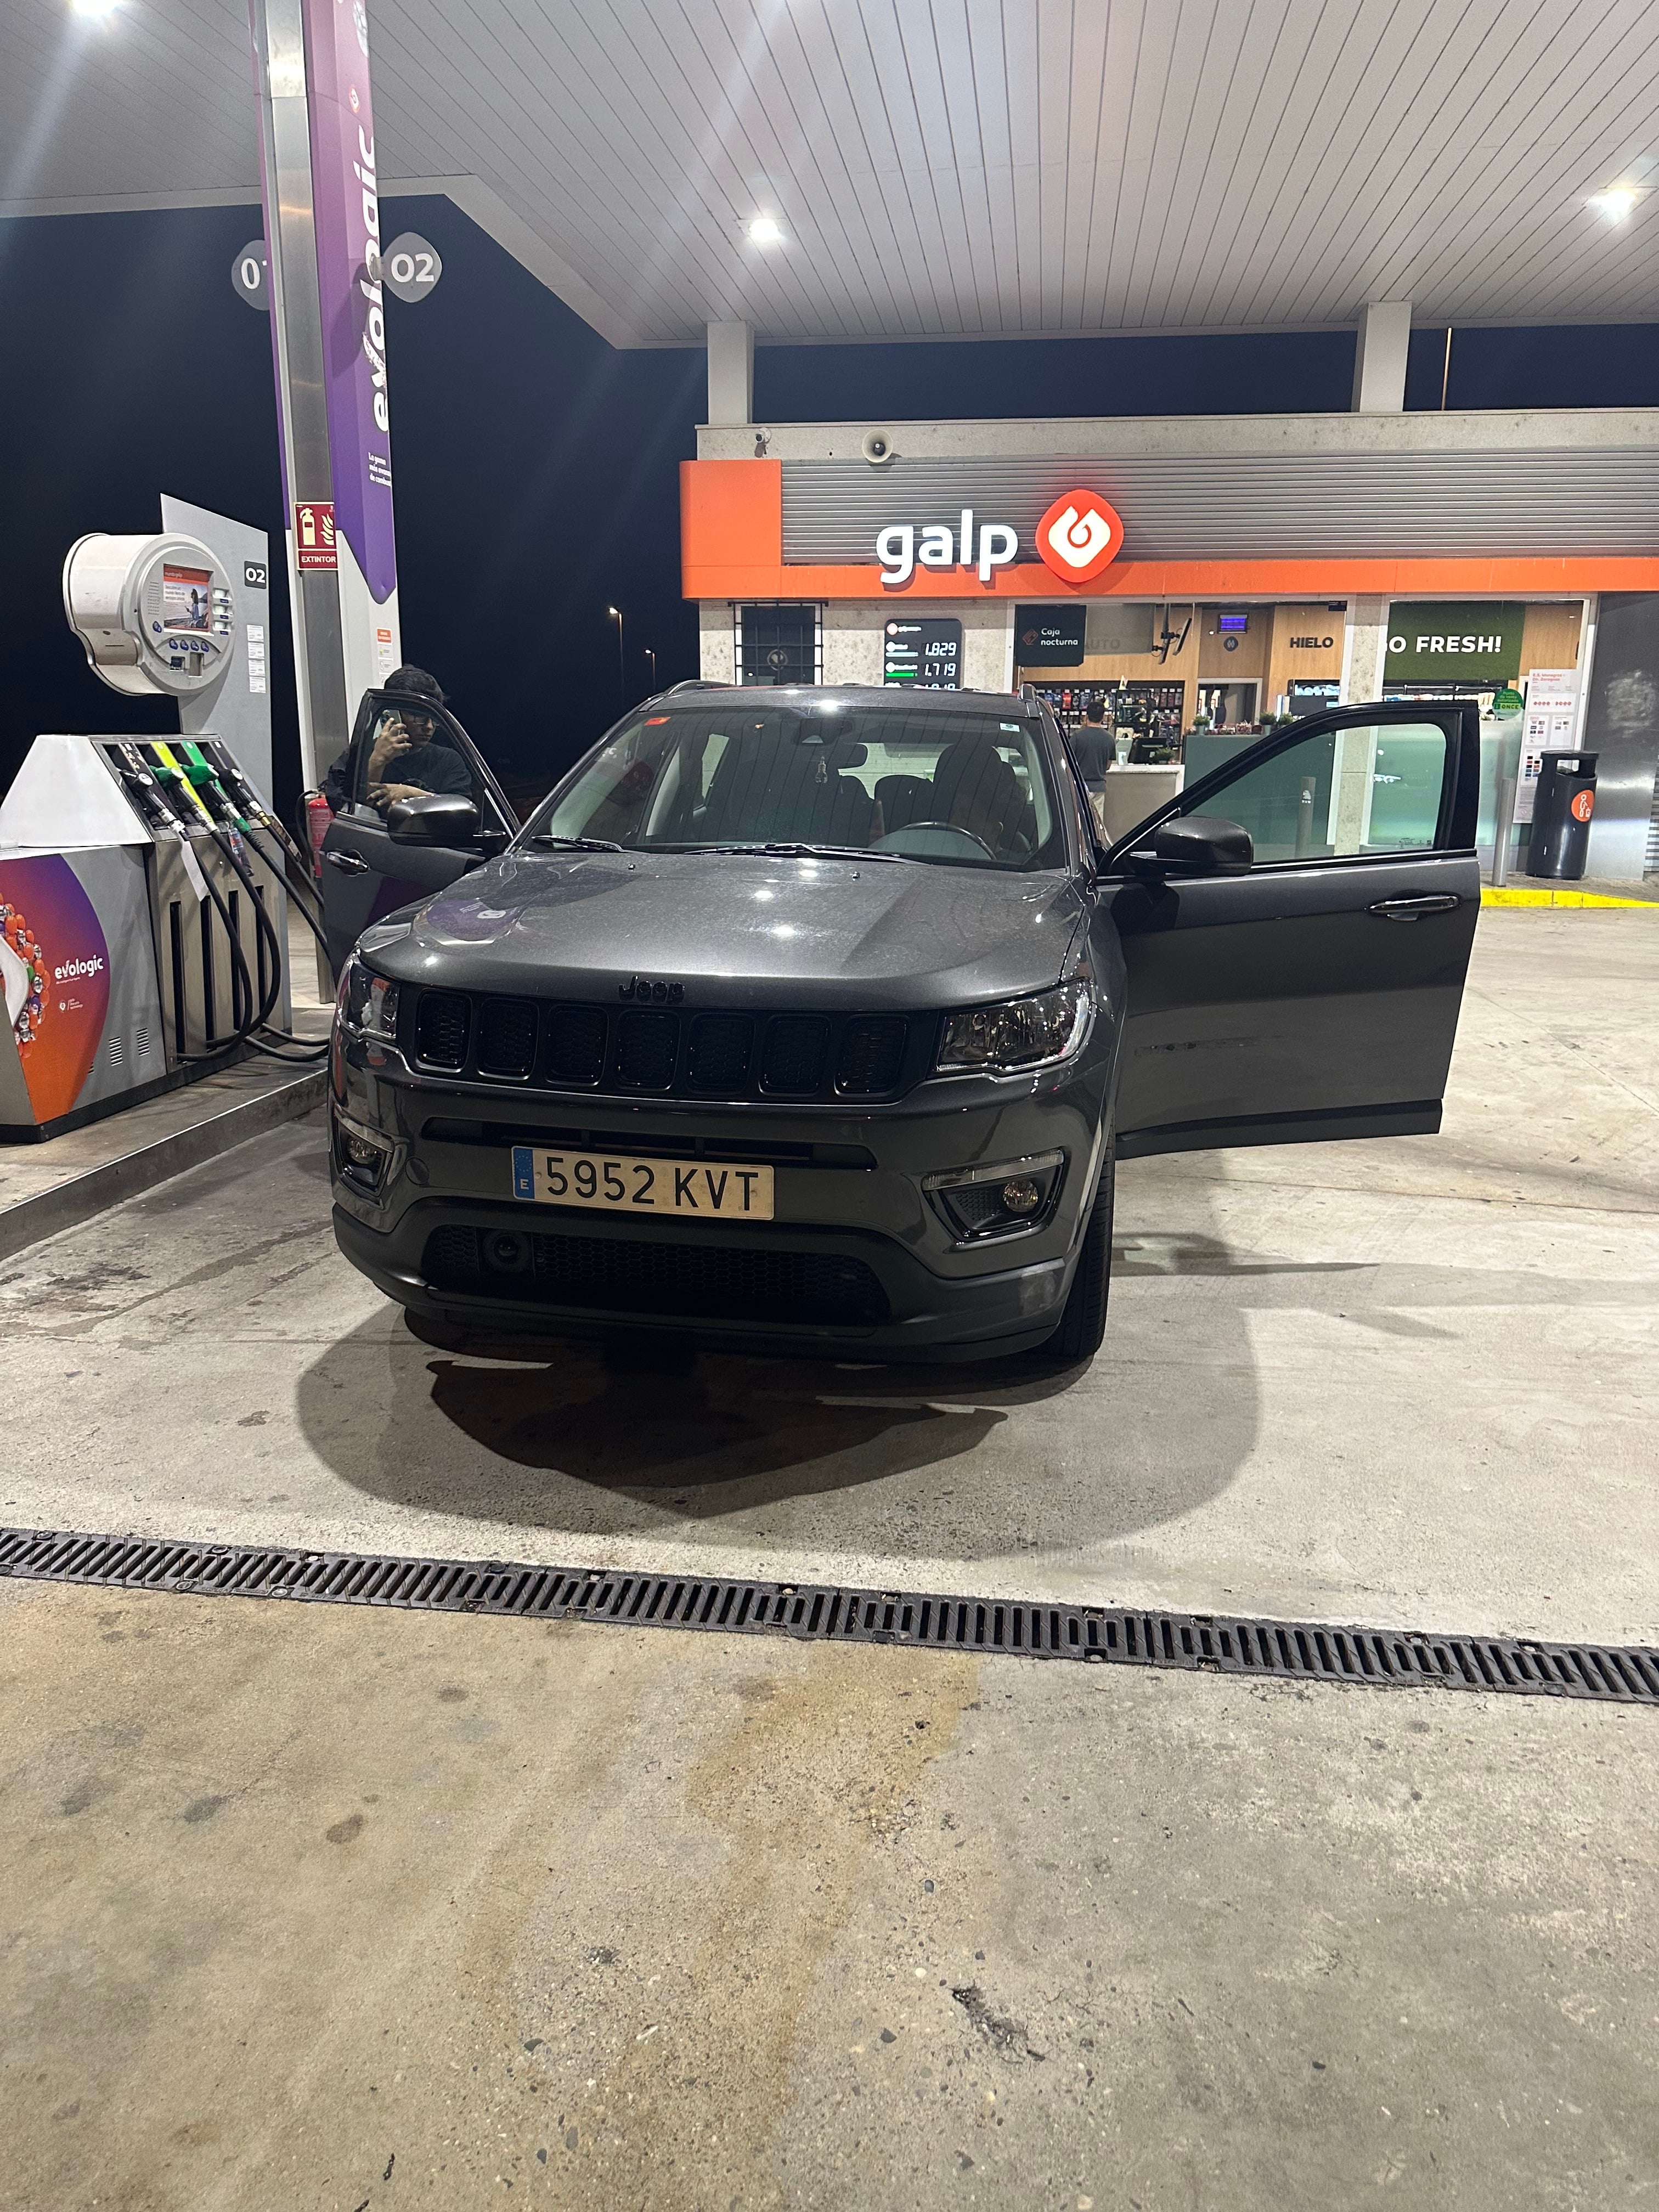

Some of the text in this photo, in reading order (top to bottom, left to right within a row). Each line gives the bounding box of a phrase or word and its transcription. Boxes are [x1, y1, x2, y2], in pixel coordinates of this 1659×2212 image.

[241, 257, 267, 289] 0
[391, 253, 434, 283] 02
[876, 509, 1018, 584] galp
[246, 567, 266, 583] 02
[1041, 628, 1060, 637] Caja
[1289, 636, 1334, 648] HIELO
[925, 642, 957, 656] 1.829
[1385, 635, 1502, 653] O FRESH!
[924, 663, 956, 676] 1.719
[55, 955, 104, 979] evologic
[618, 975, 685, 1005] Jeep
[520, 1156, 759, 1211] E 5952 KVT
